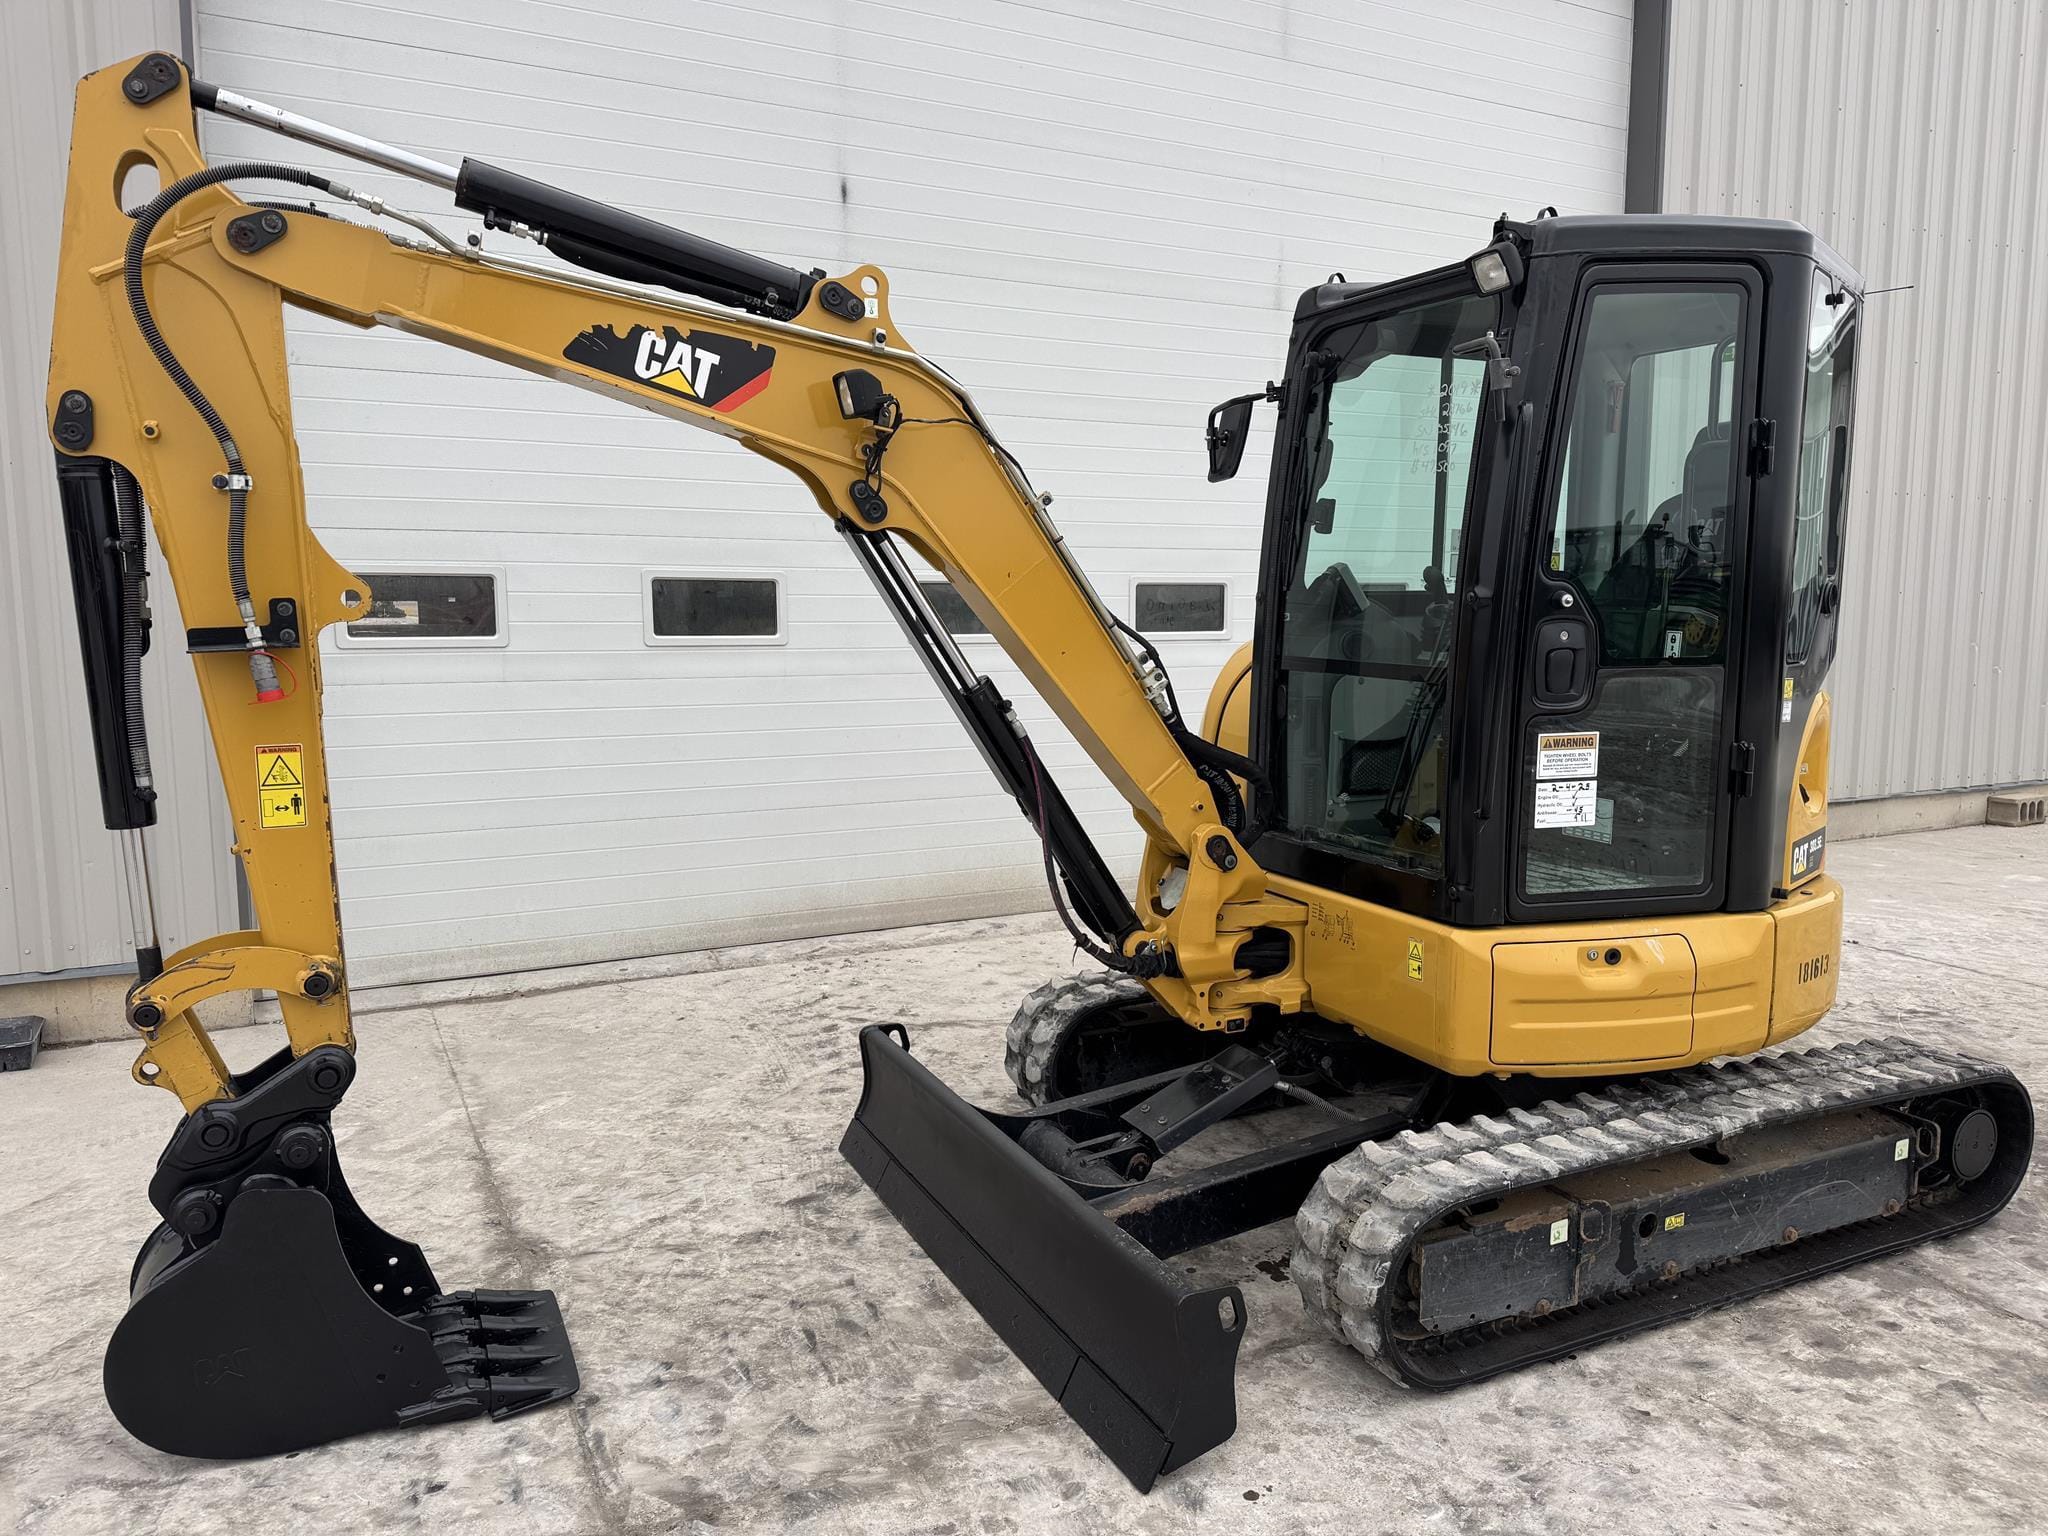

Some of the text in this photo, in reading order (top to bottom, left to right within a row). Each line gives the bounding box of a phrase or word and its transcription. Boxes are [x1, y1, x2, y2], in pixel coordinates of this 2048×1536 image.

[634, 330, 721, 400] CAT
[1553, 737, 1594, 748] WARNING
[1793, 842, 1809, 876] CAT
[1799, 954, 1830, 985] 181613
